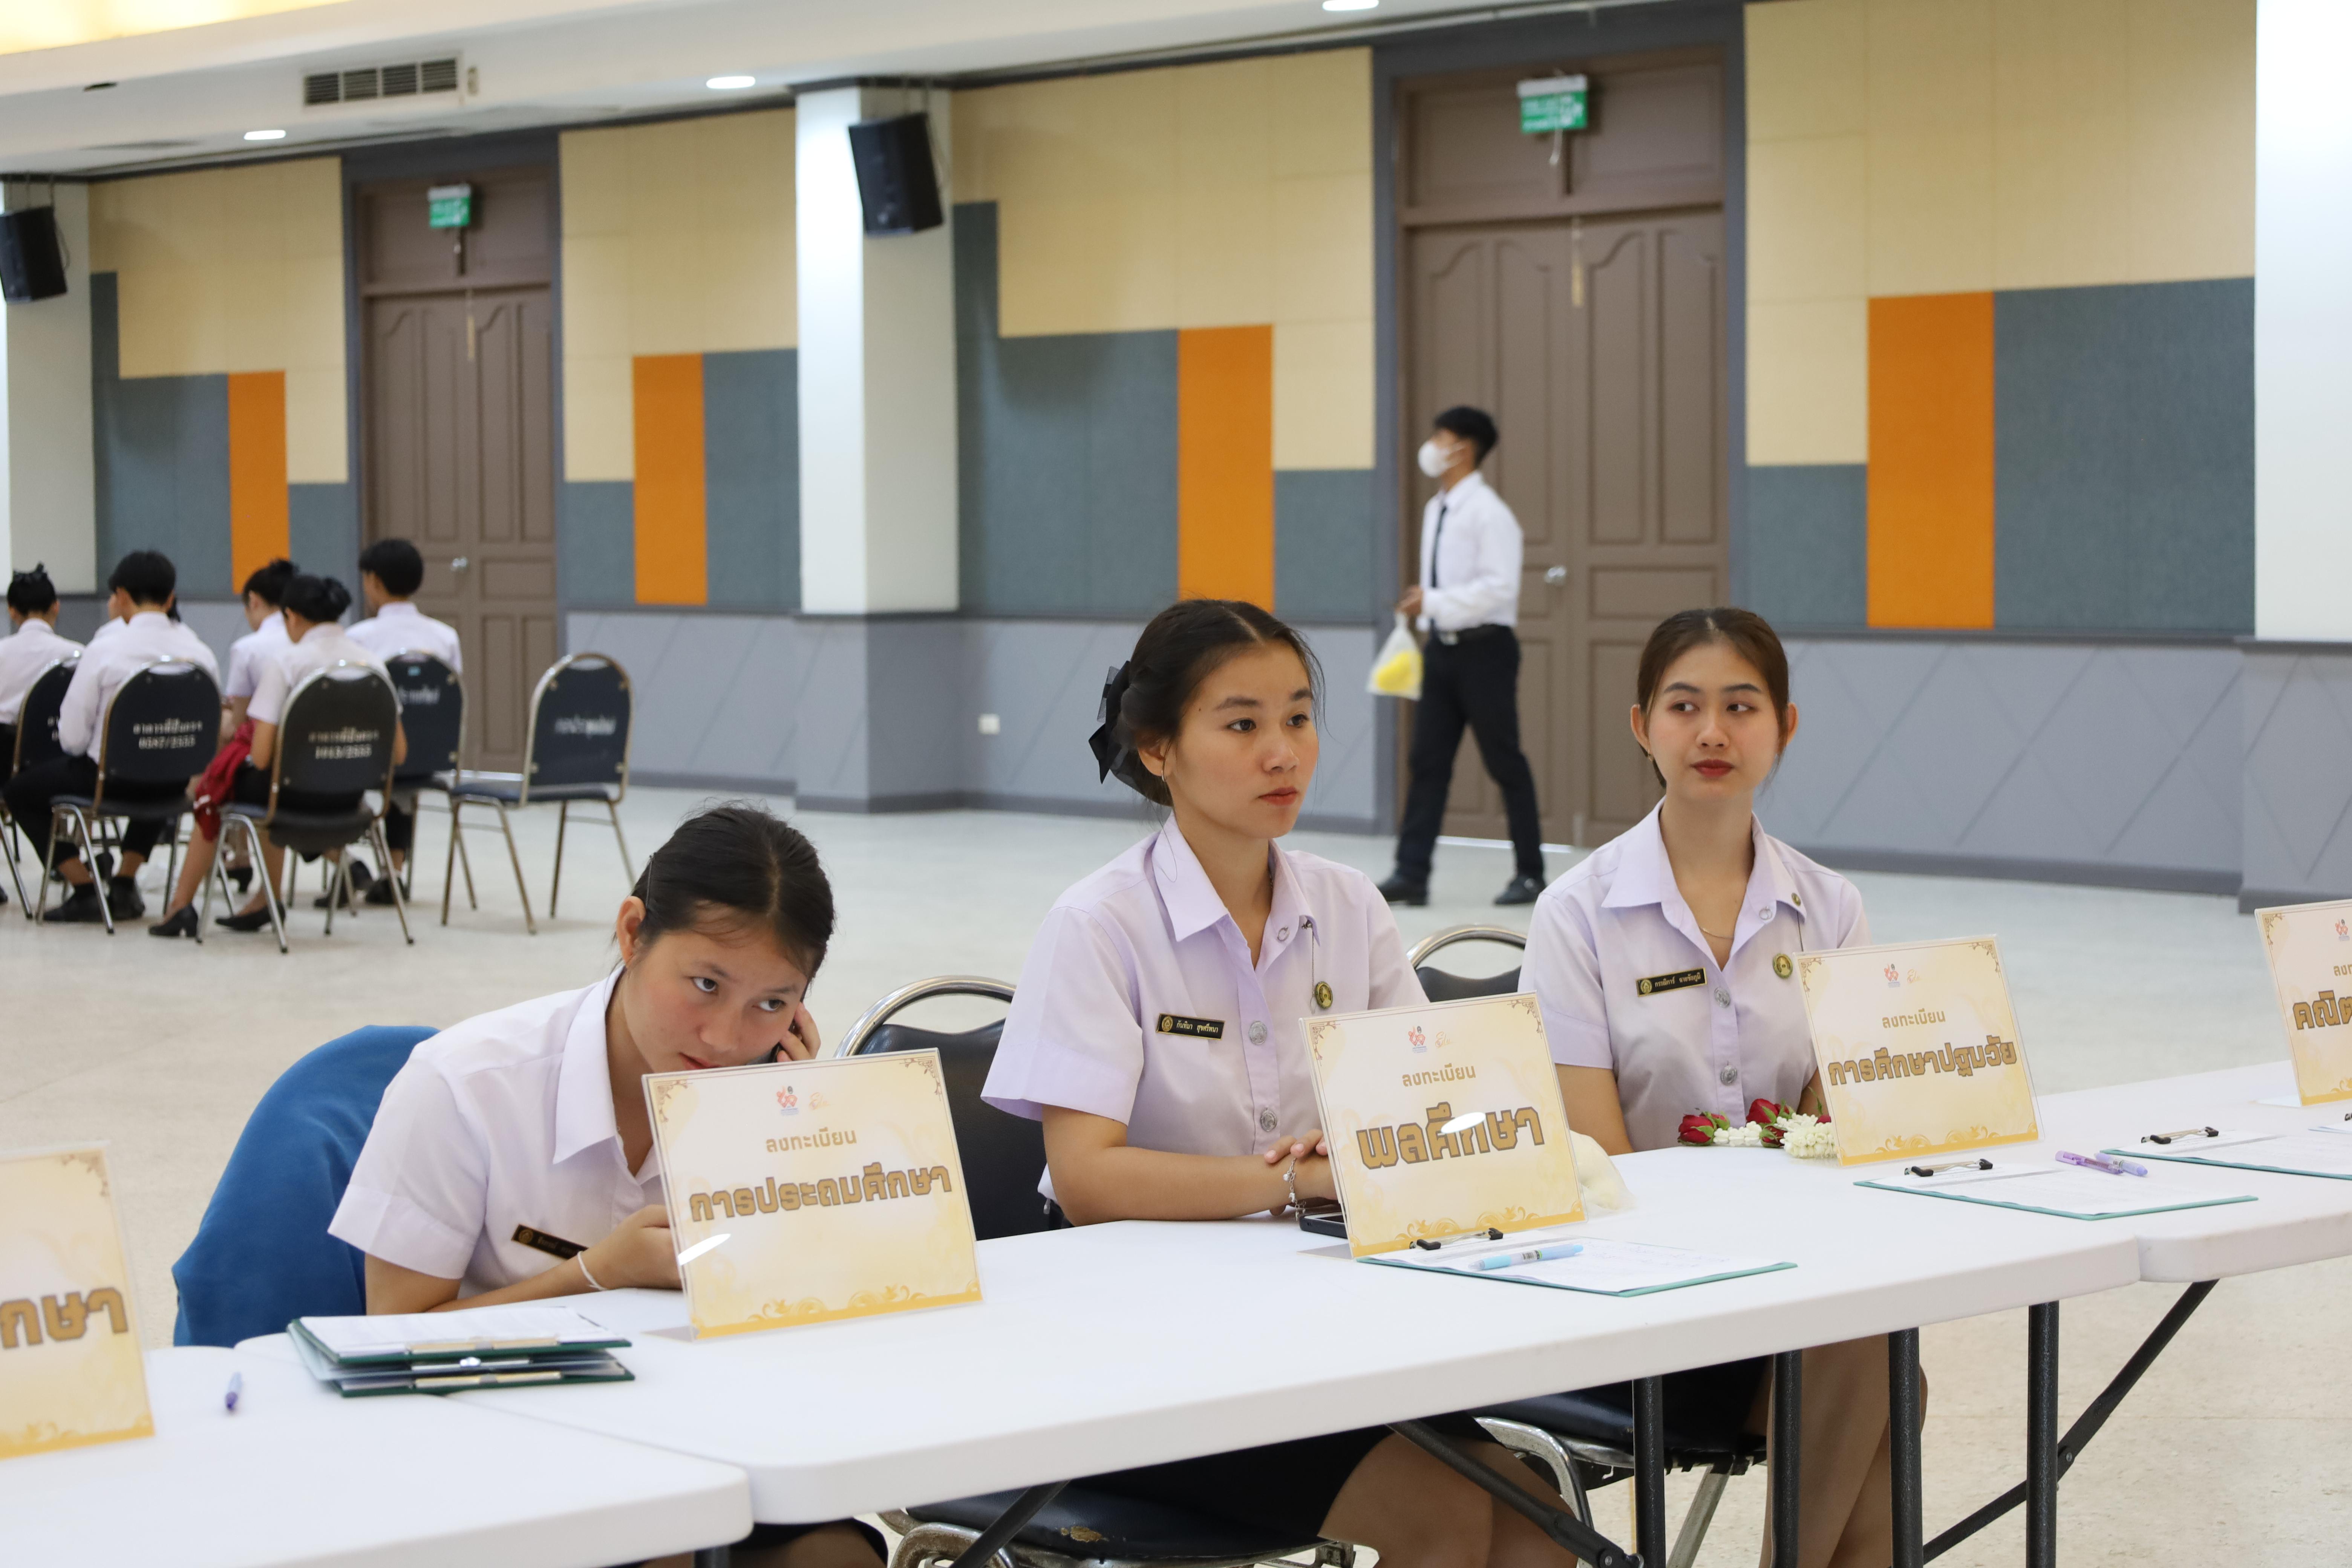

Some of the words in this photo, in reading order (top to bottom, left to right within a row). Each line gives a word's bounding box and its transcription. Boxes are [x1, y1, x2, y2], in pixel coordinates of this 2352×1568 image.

[1882, 1008, 1946, 1028] ลงทะเบียน
[1402, 1063, 1476, 1087] ลงทะเบียน
[1828, 1035, 2017, 1086] การศึกษาปฐมวัย
[766, 1127, 857, 1152] ลงทะเบียน
[1356, 1101, 1545, 1170] พลศึกษา
[689, 1162, 952, 1222] การประถมศึกษา
